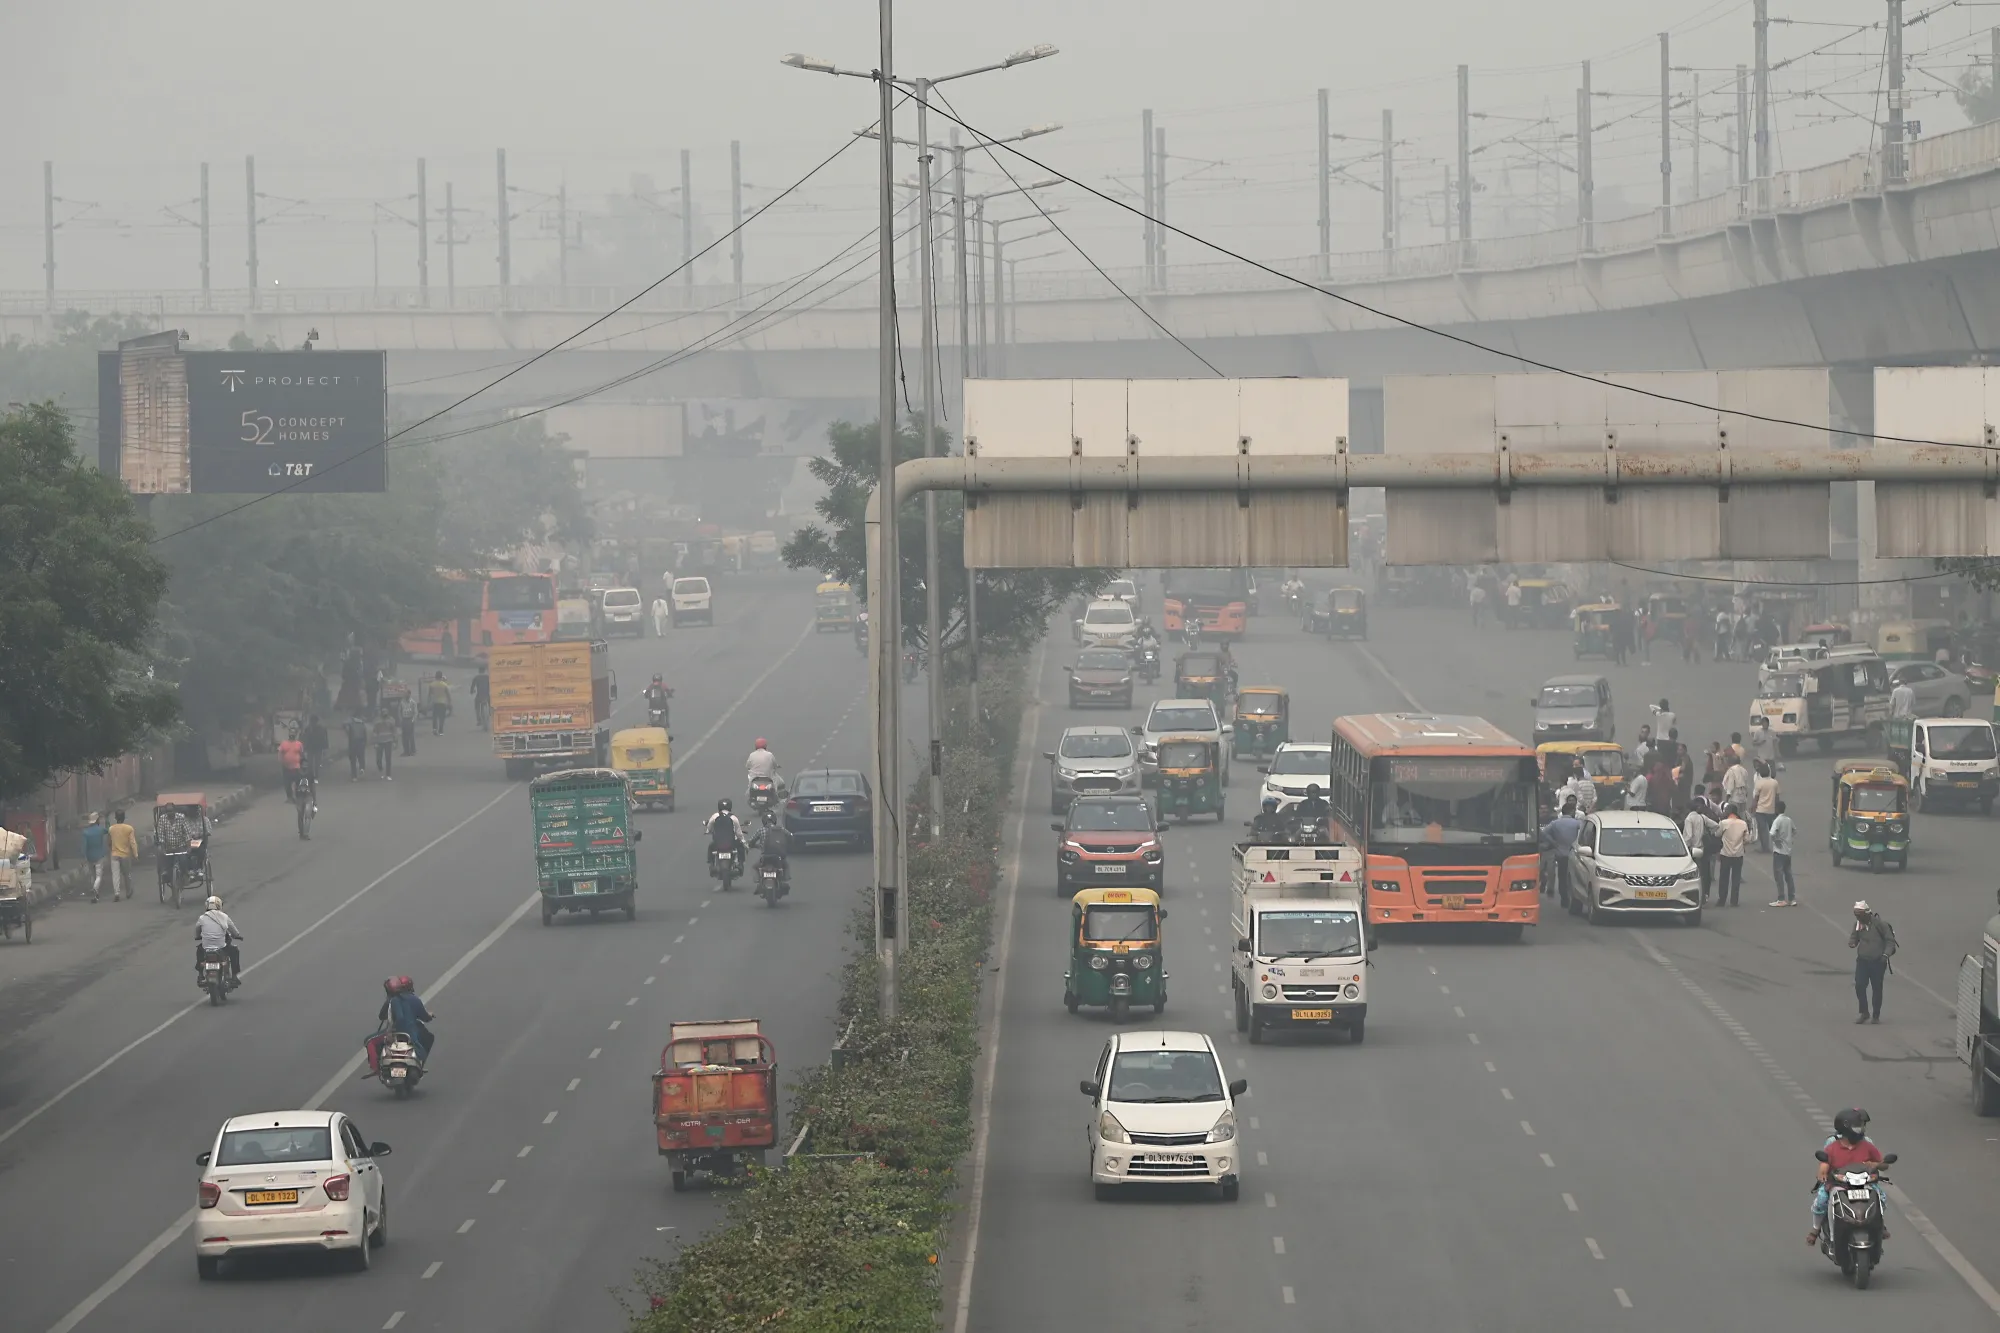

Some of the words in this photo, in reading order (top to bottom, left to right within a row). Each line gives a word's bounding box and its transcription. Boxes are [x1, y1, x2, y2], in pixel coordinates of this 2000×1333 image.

[255, 376, 341, 386] PROJECT
[240, 409, 275, 445] 52
[278, 417, 345, 427] CONCEPT
[279, 431, 329, 441] HOMES
[285, 463, 313, 476] T&T
[250, 1194, 260, 1202] DL
[278, 1191, 296, 1201] 1323
